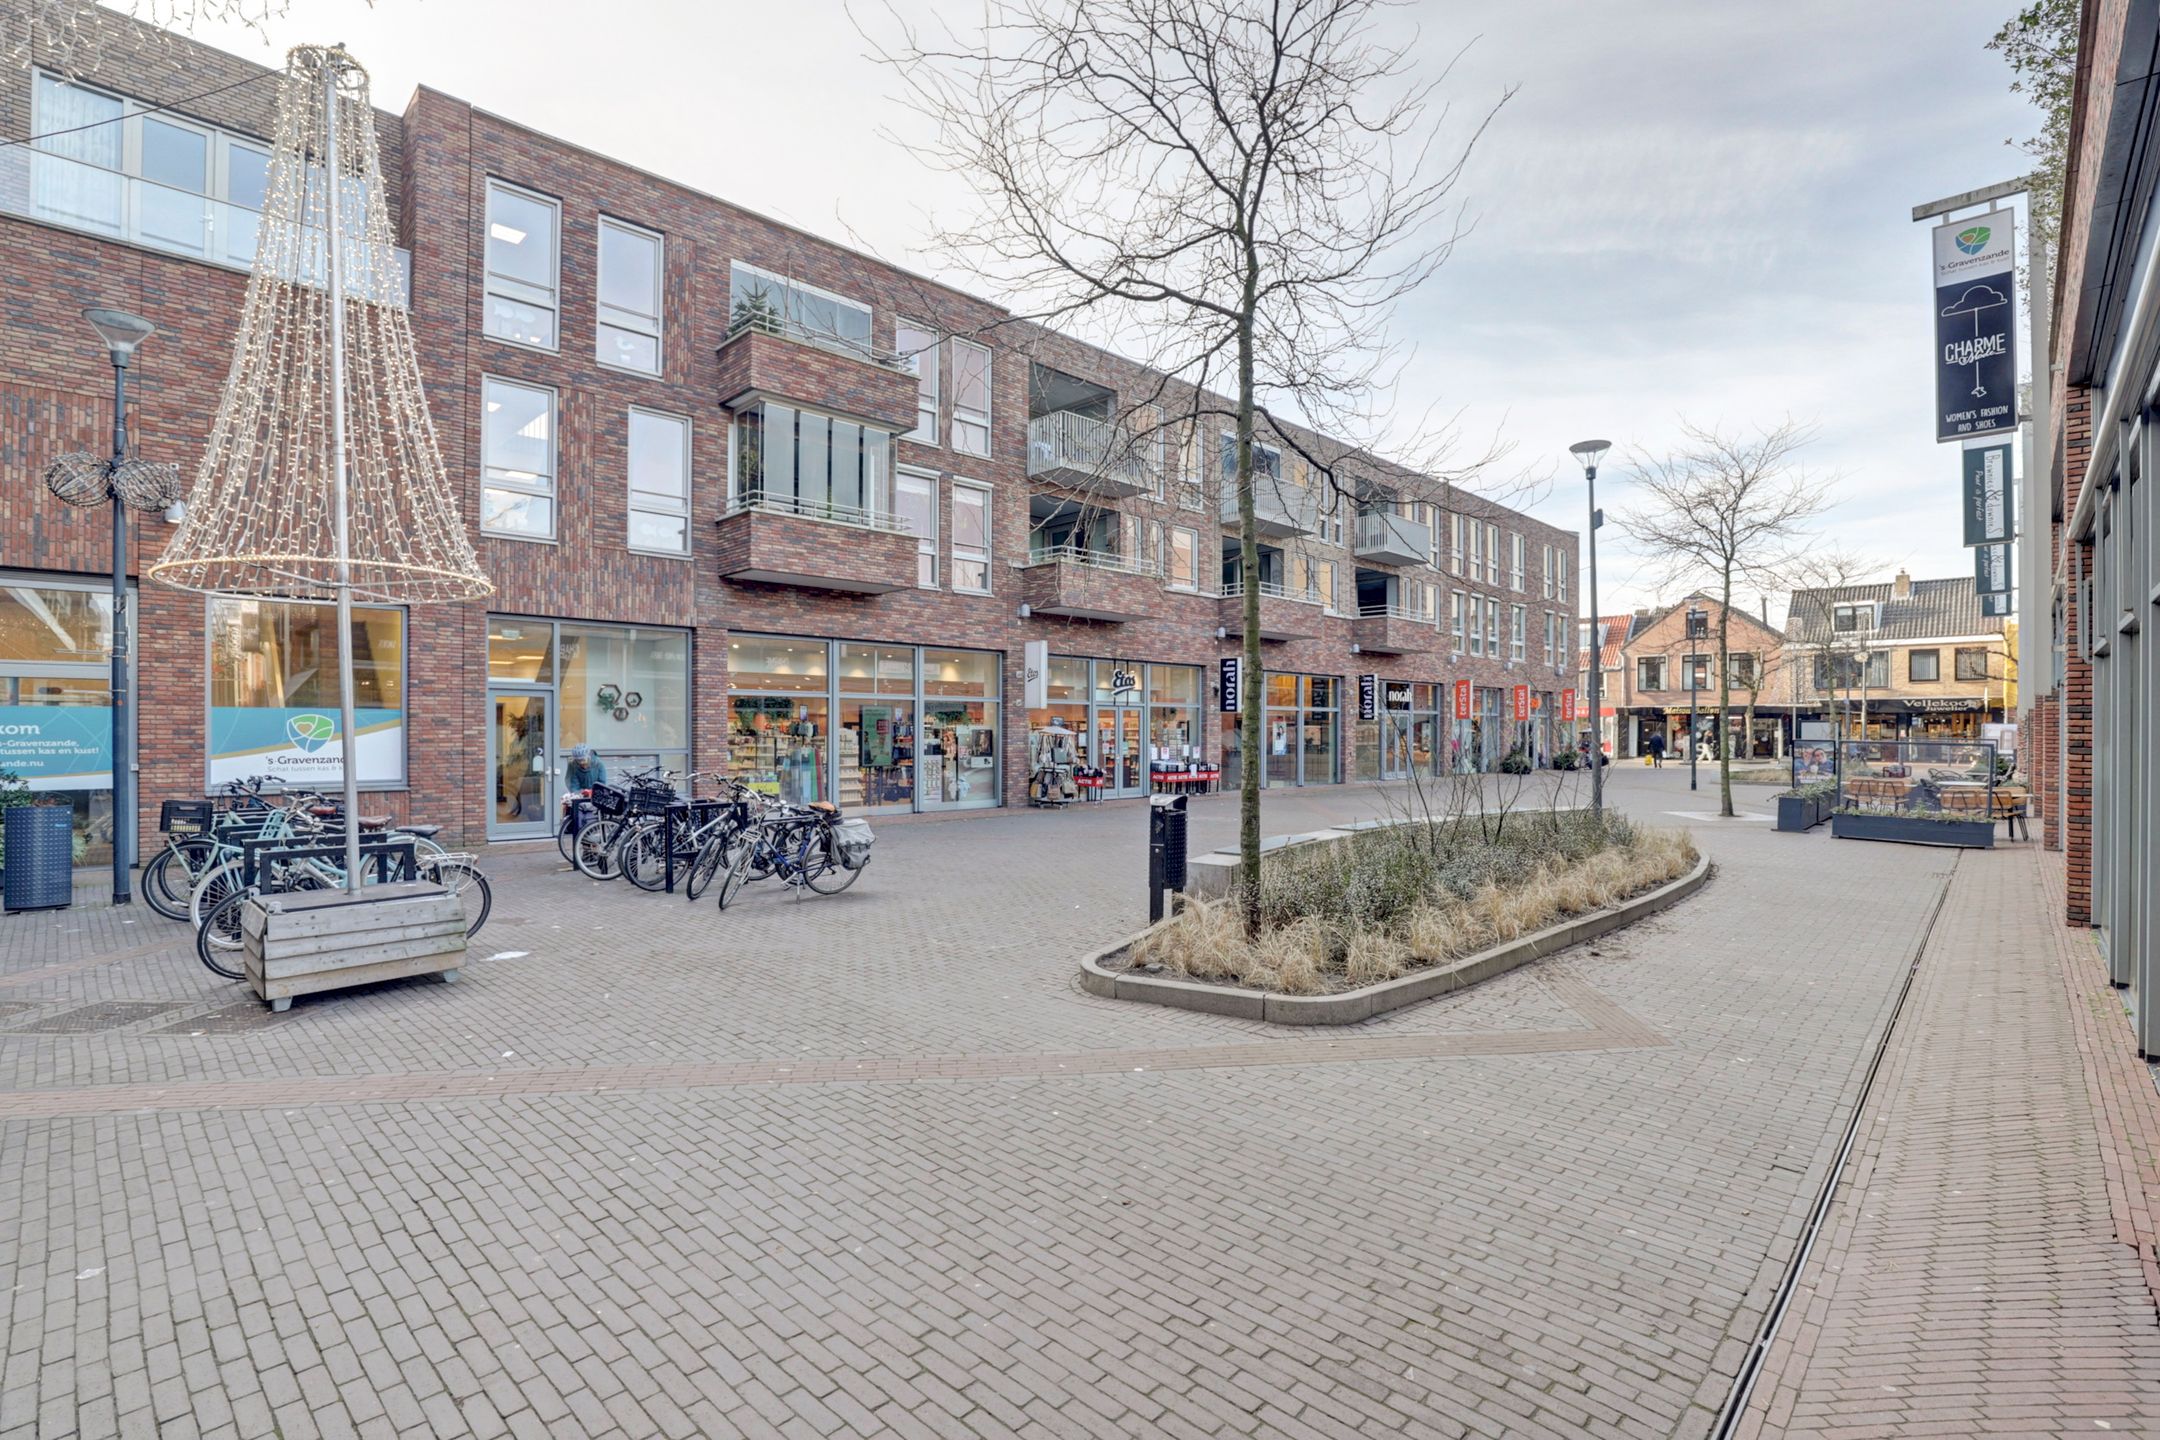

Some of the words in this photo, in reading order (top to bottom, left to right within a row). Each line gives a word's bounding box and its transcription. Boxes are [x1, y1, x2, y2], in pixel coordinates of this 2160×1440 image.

[1945, 333, 2006, 362] CHARME
[1945, 410, 1977, 423] WOMEN'S
[1980, 405, 2009, 418] FASHION
[1958, 422, 1972, 432] AND
[1975, 419, 1996, 430] SHOES
[1112, 669, 1136, 690] Etos
[1222, 659, 1236, 711] norah
[1361, 676, 1373, 719] norah
[1388, 688, 1413, 702] norah
[1459, 684, 1467, 716] terStal
[74, 746, 99, 754] kust!
